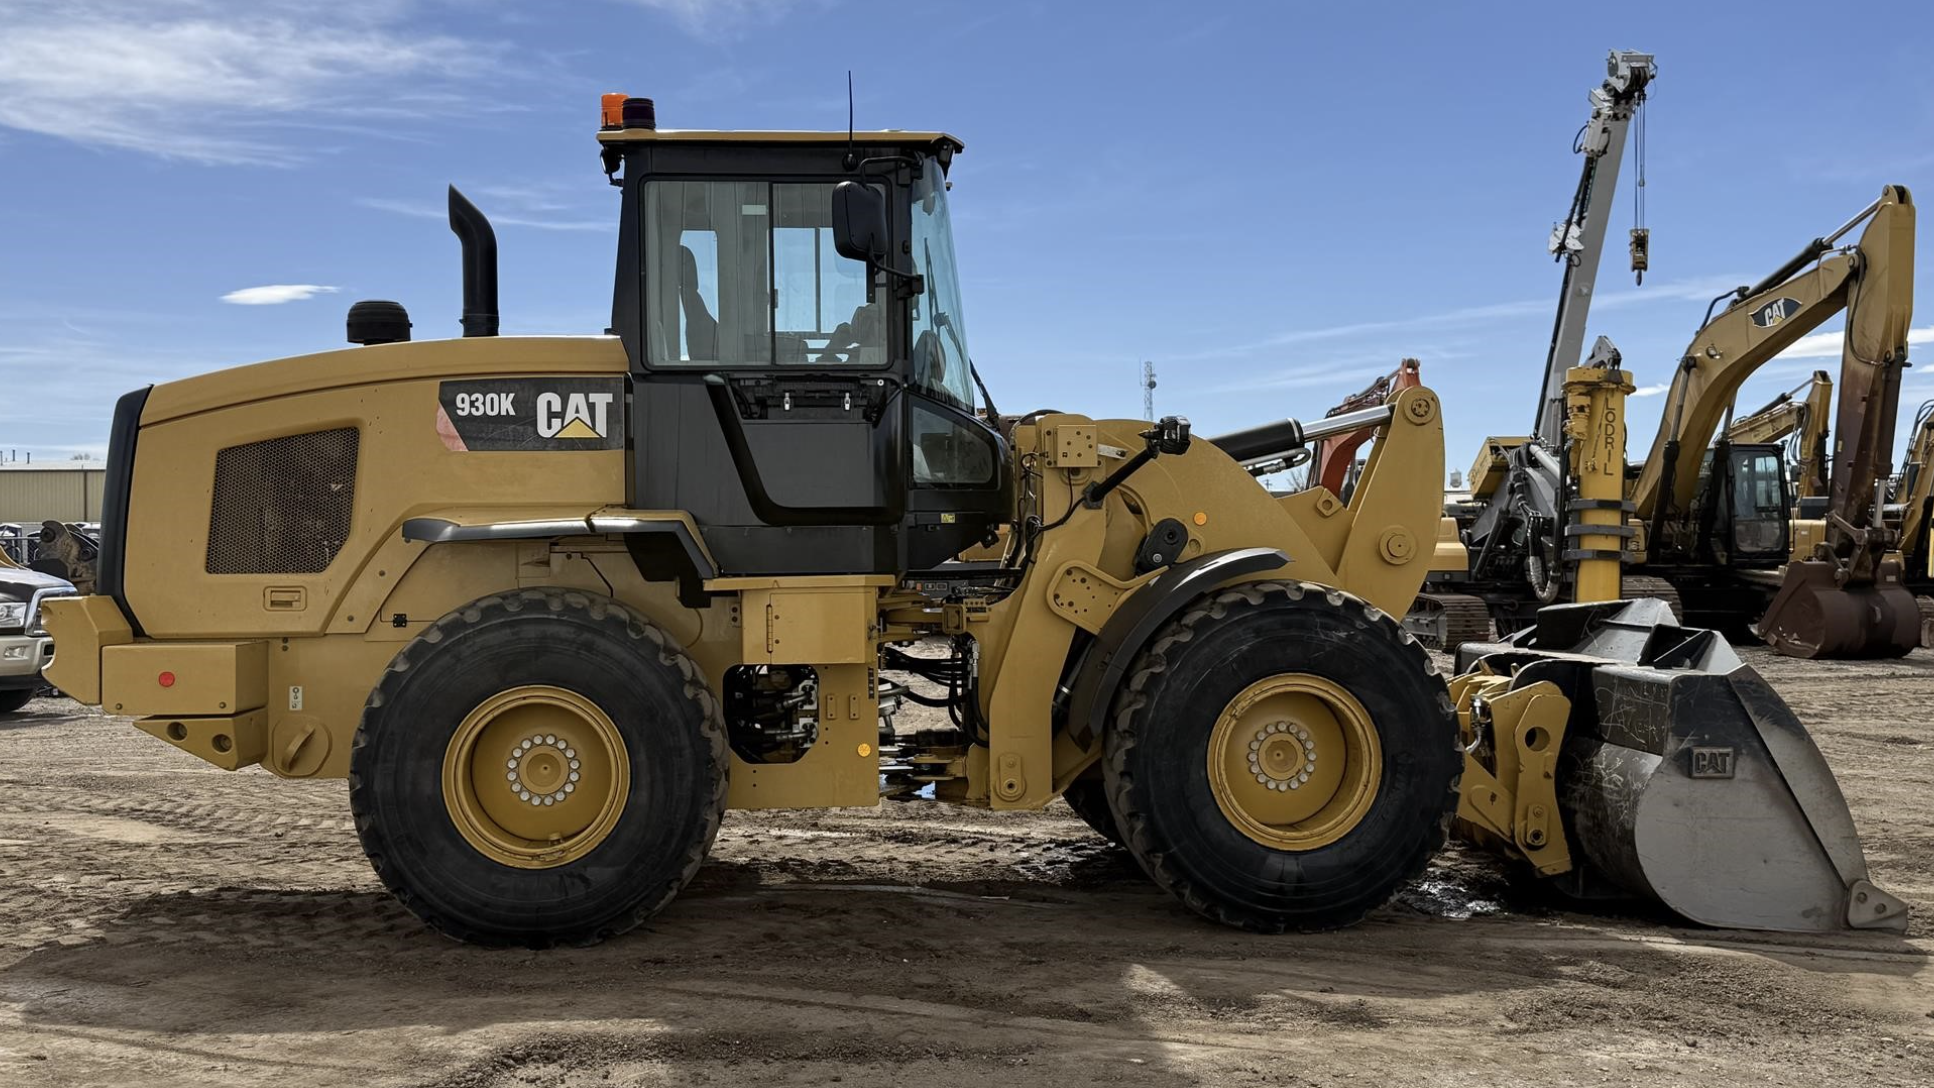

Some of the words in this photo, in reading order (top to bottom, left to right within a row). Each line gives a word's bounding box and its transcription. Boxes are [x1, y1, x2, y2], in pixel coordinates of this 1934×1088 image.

[1764, 297, 1786, 327] CAT
[456, 392, 516, 417] 930K
[536, 392, 613, 439] CAT
[1604, 397, 1616, 476] LODRIL
[1695, 752, 1730, 774] CAT
